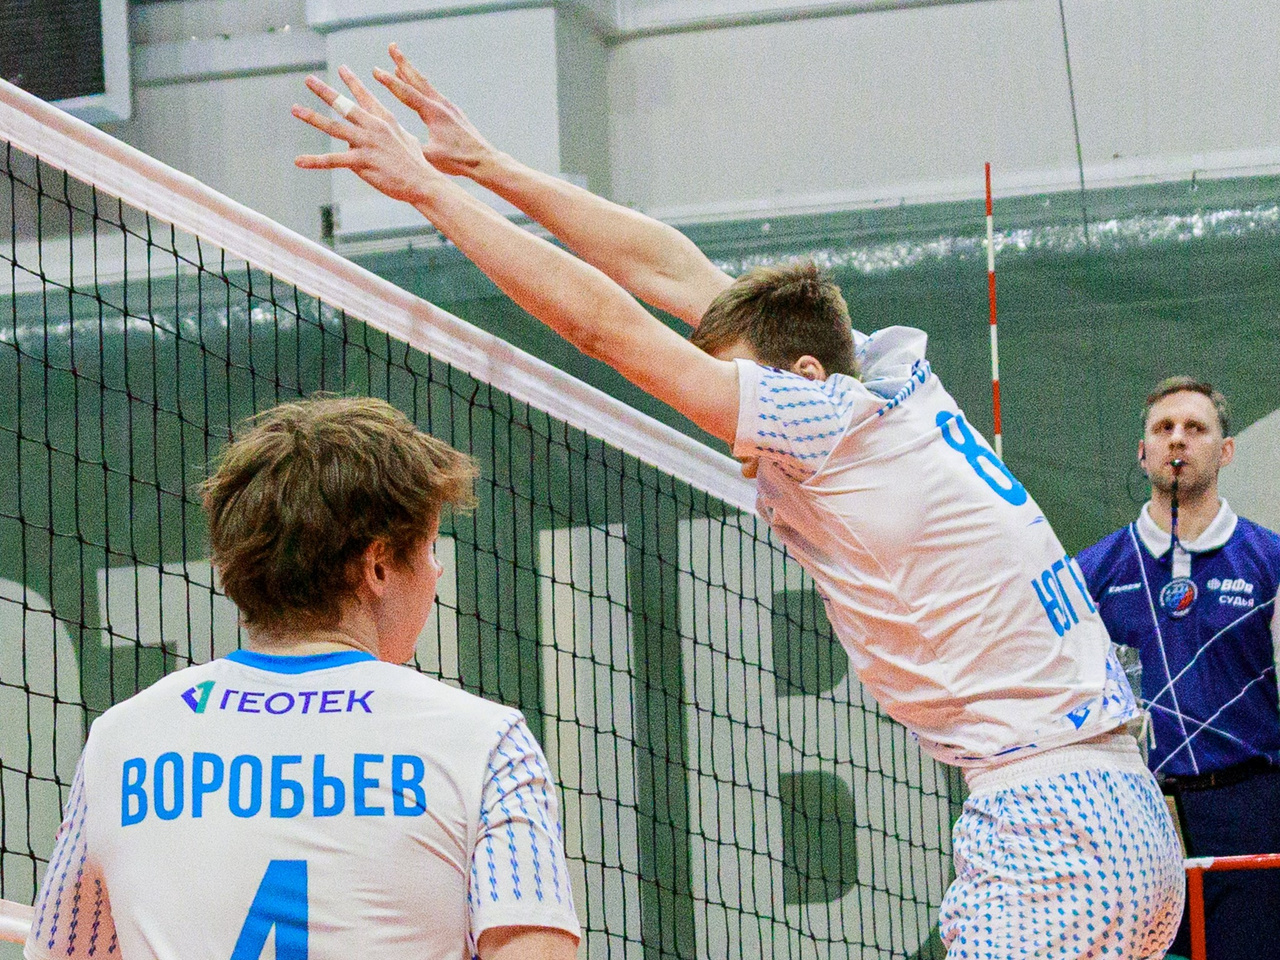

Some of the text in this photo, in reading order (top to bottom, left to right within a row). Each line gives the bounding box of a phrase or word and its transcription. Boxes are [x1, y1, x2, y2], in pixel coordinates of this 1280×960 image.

[935, 410, 1028, 507] 8
[1219, 596, 1255, 608] СУДЬЯ
[218, 687, 375, 715] ГЕОТЕК
[120, 751, 428, 828] ВОРОБЬЕВ
